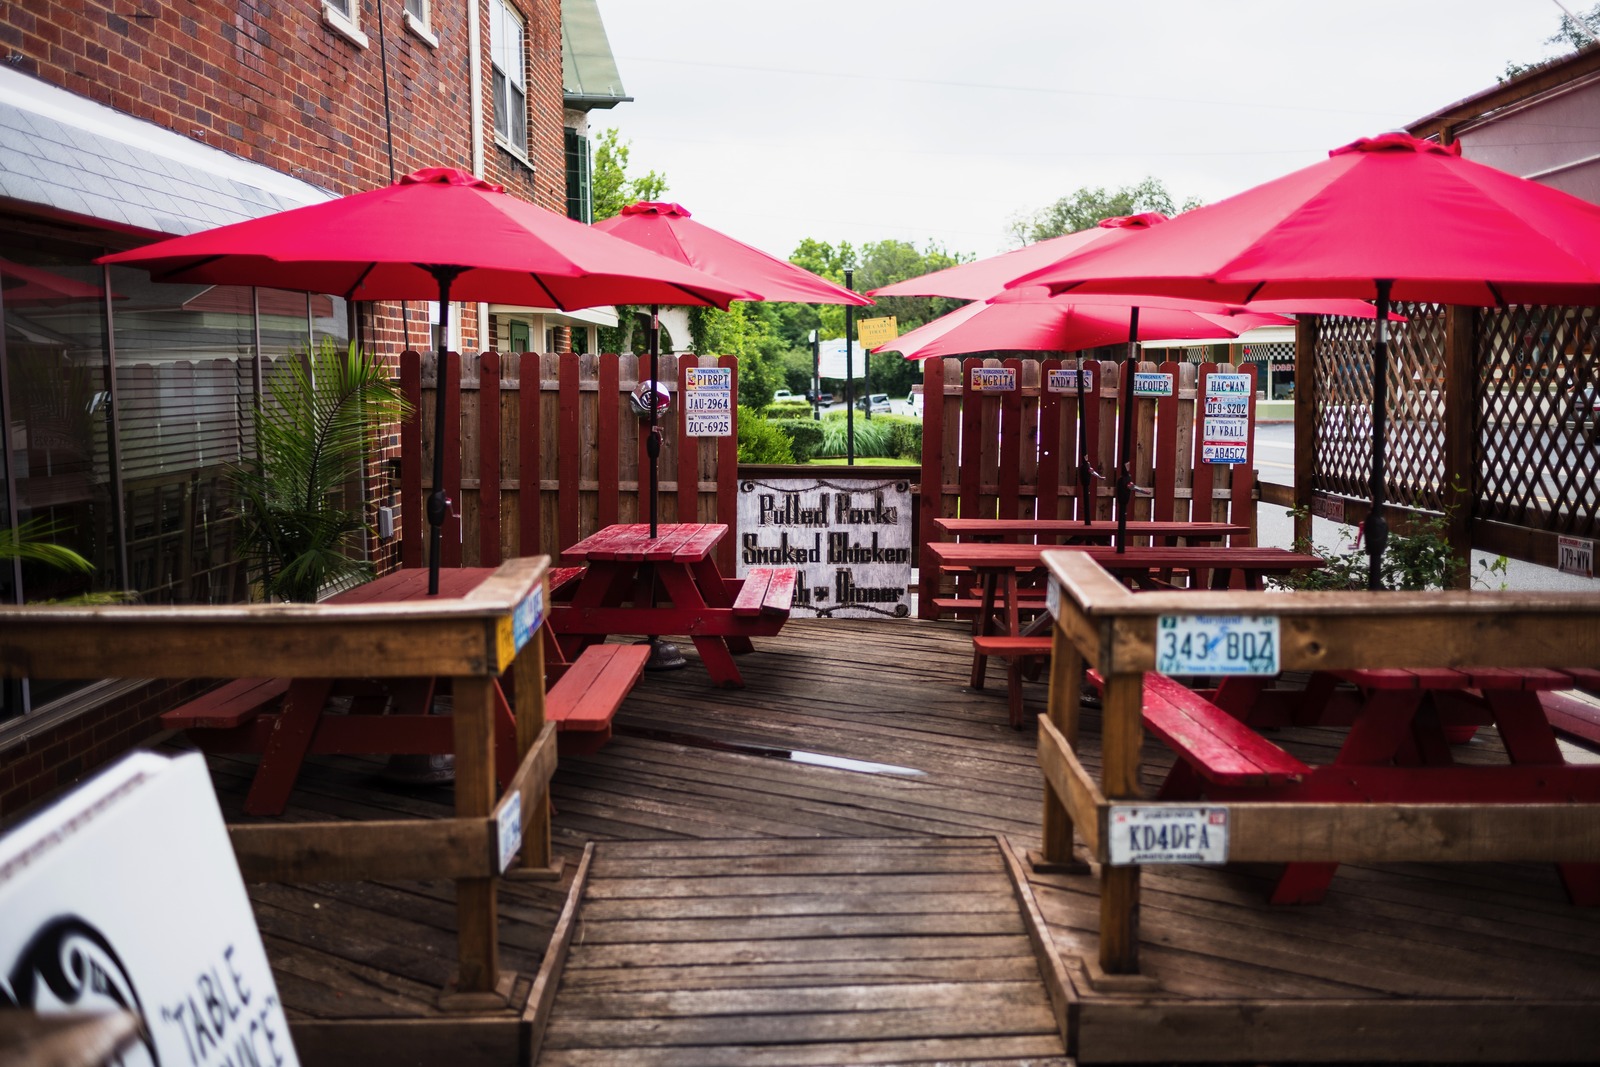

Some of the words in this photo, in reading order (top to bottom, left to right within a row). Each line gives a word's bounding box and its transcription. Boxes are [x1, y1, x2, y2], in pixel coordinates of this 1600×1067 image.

[697, 374, 728, 386] PIR8PT
[689, 398, 728, 409] JAU-2964
[689, 421, 729, 433] ZCC-6925
[1219, 425, 1244, 437] VBALL
[757, 492, 830, 528] Pulled
[834, 491, 898, 526] Pork
[742, 531, 822, 566] Smoked
[827, 531, 910, 565] Chicken
[835, 568, 904, 604] Dinner
[1163, 631, 1208, 660] 343
[1129, 823, 1210, 851] KD4DFA
